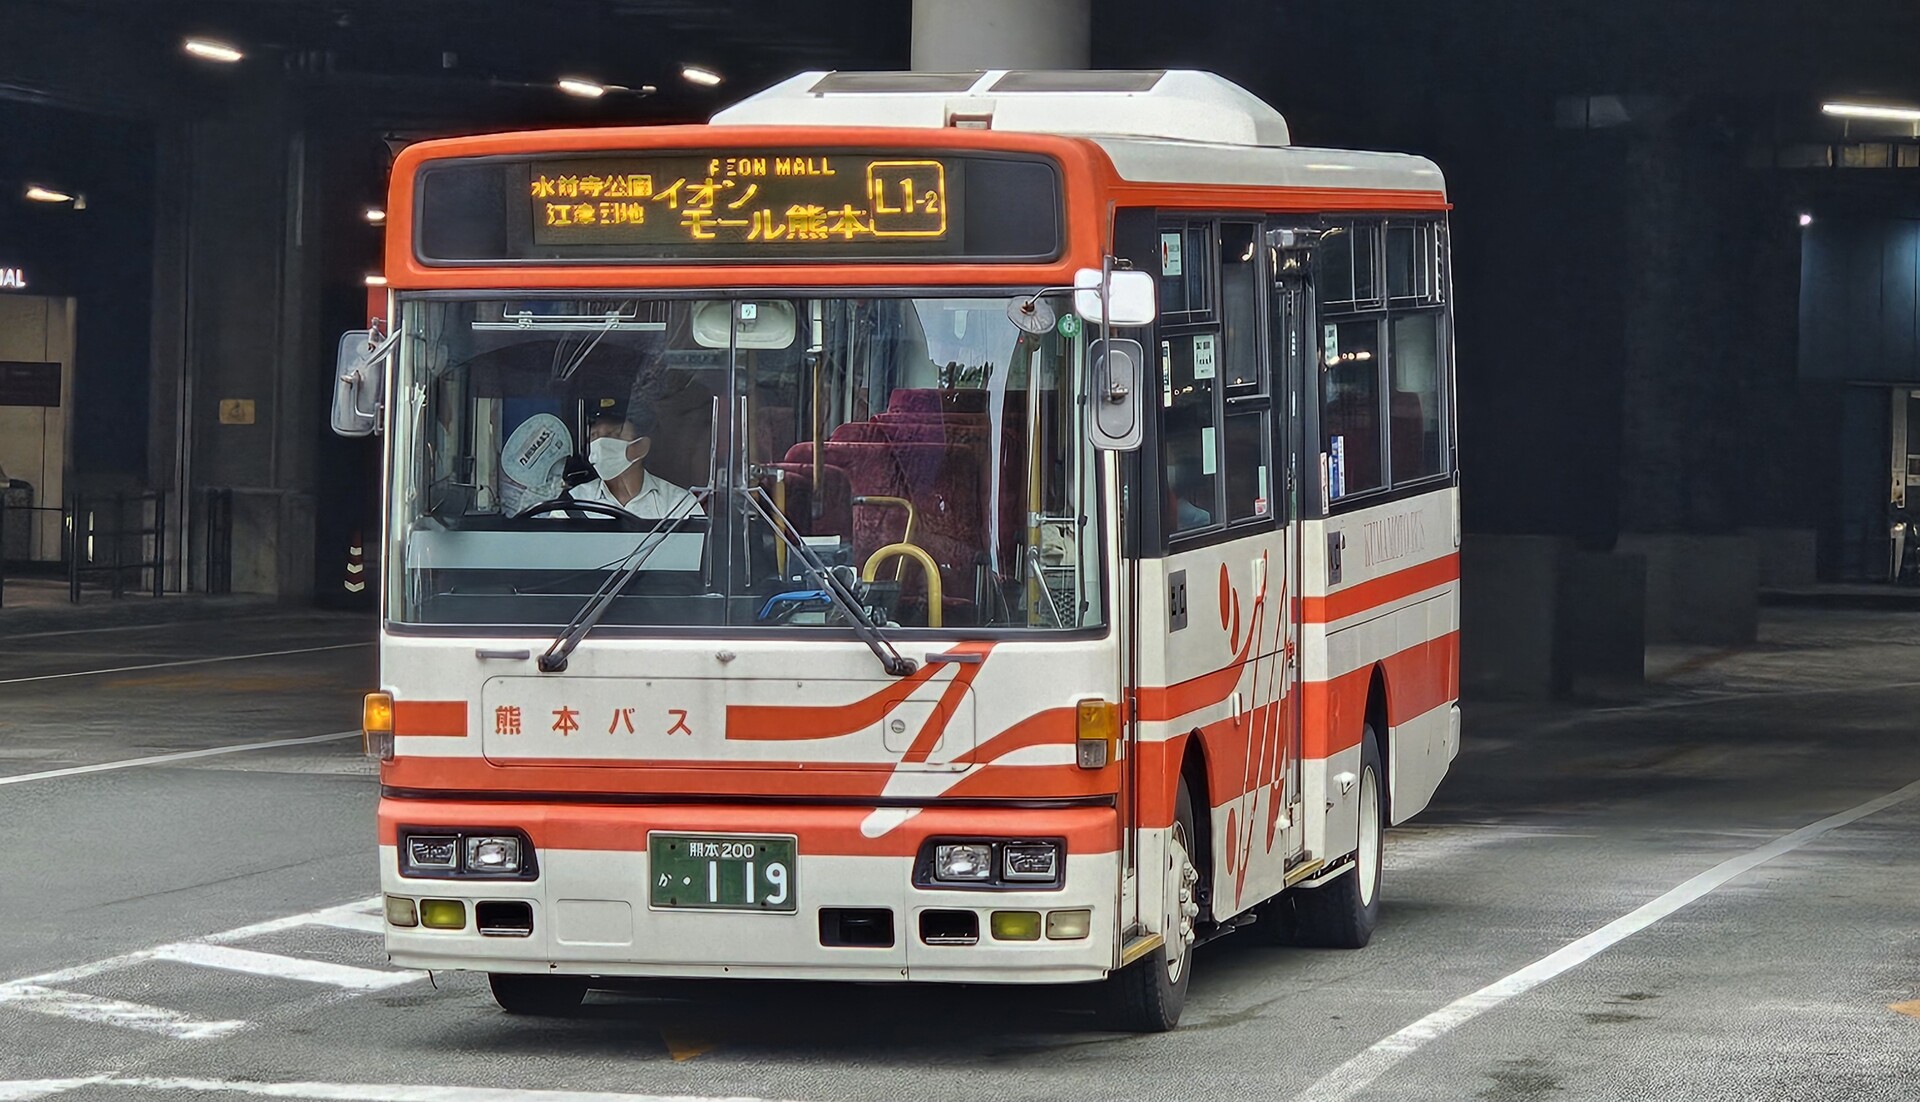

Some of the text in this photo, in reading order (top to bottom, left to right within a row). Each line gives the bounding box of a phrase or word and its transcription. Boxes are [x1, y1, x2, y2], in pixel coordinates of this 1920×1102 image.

[775, 158, 836, 176] MALL
[531, 174, 653, 198] 水前寺公園
[652, 177, 758, 209] イオン
[546, 202, 645, 226] 江津団地
[680, 204, 870, 240] モール熊本
[495, 705, 692, 736] 熊本バス
